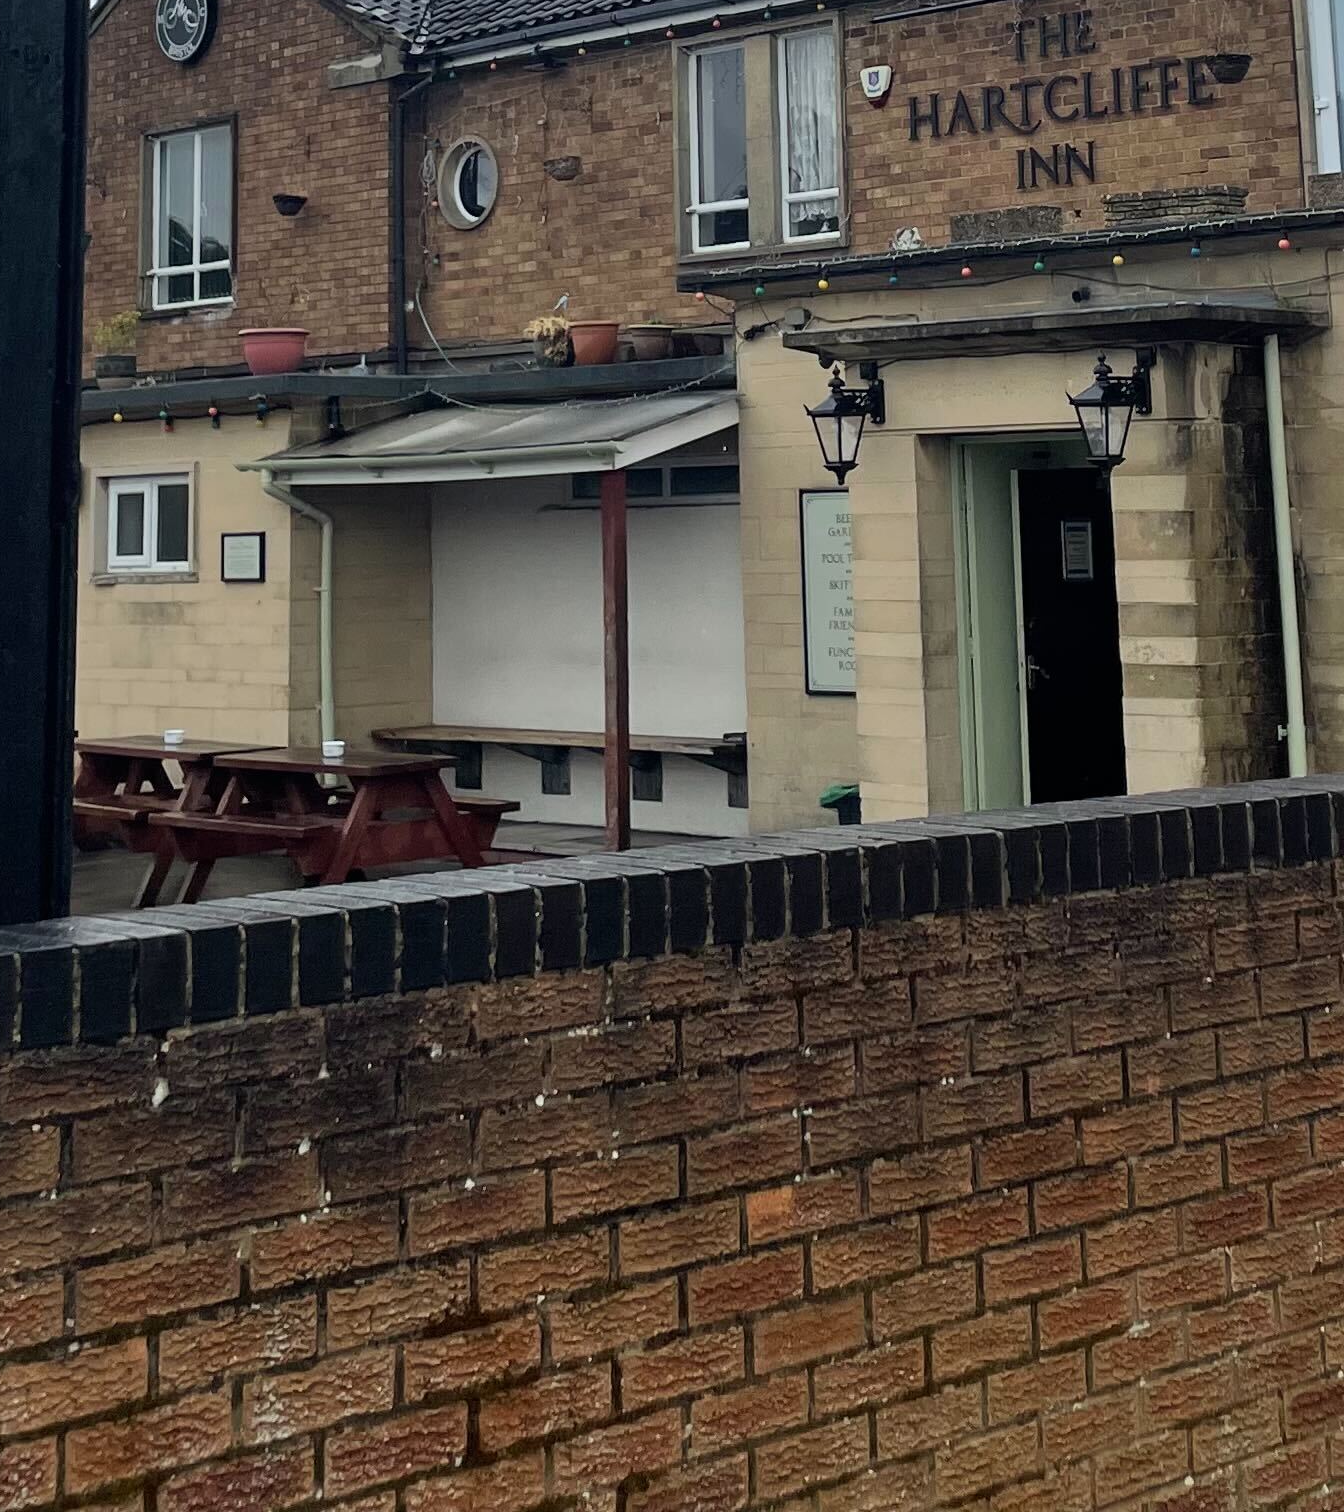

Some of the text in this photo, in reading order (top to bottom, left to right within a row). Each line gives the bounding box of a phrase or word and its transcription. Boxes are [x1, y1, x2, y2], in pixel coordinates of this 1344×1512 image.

[1010, 9, 1097, 63] THE
[907, 55, 1215, 142] HARTCLIFFE
[1015, 140, 1096, 190] INN
